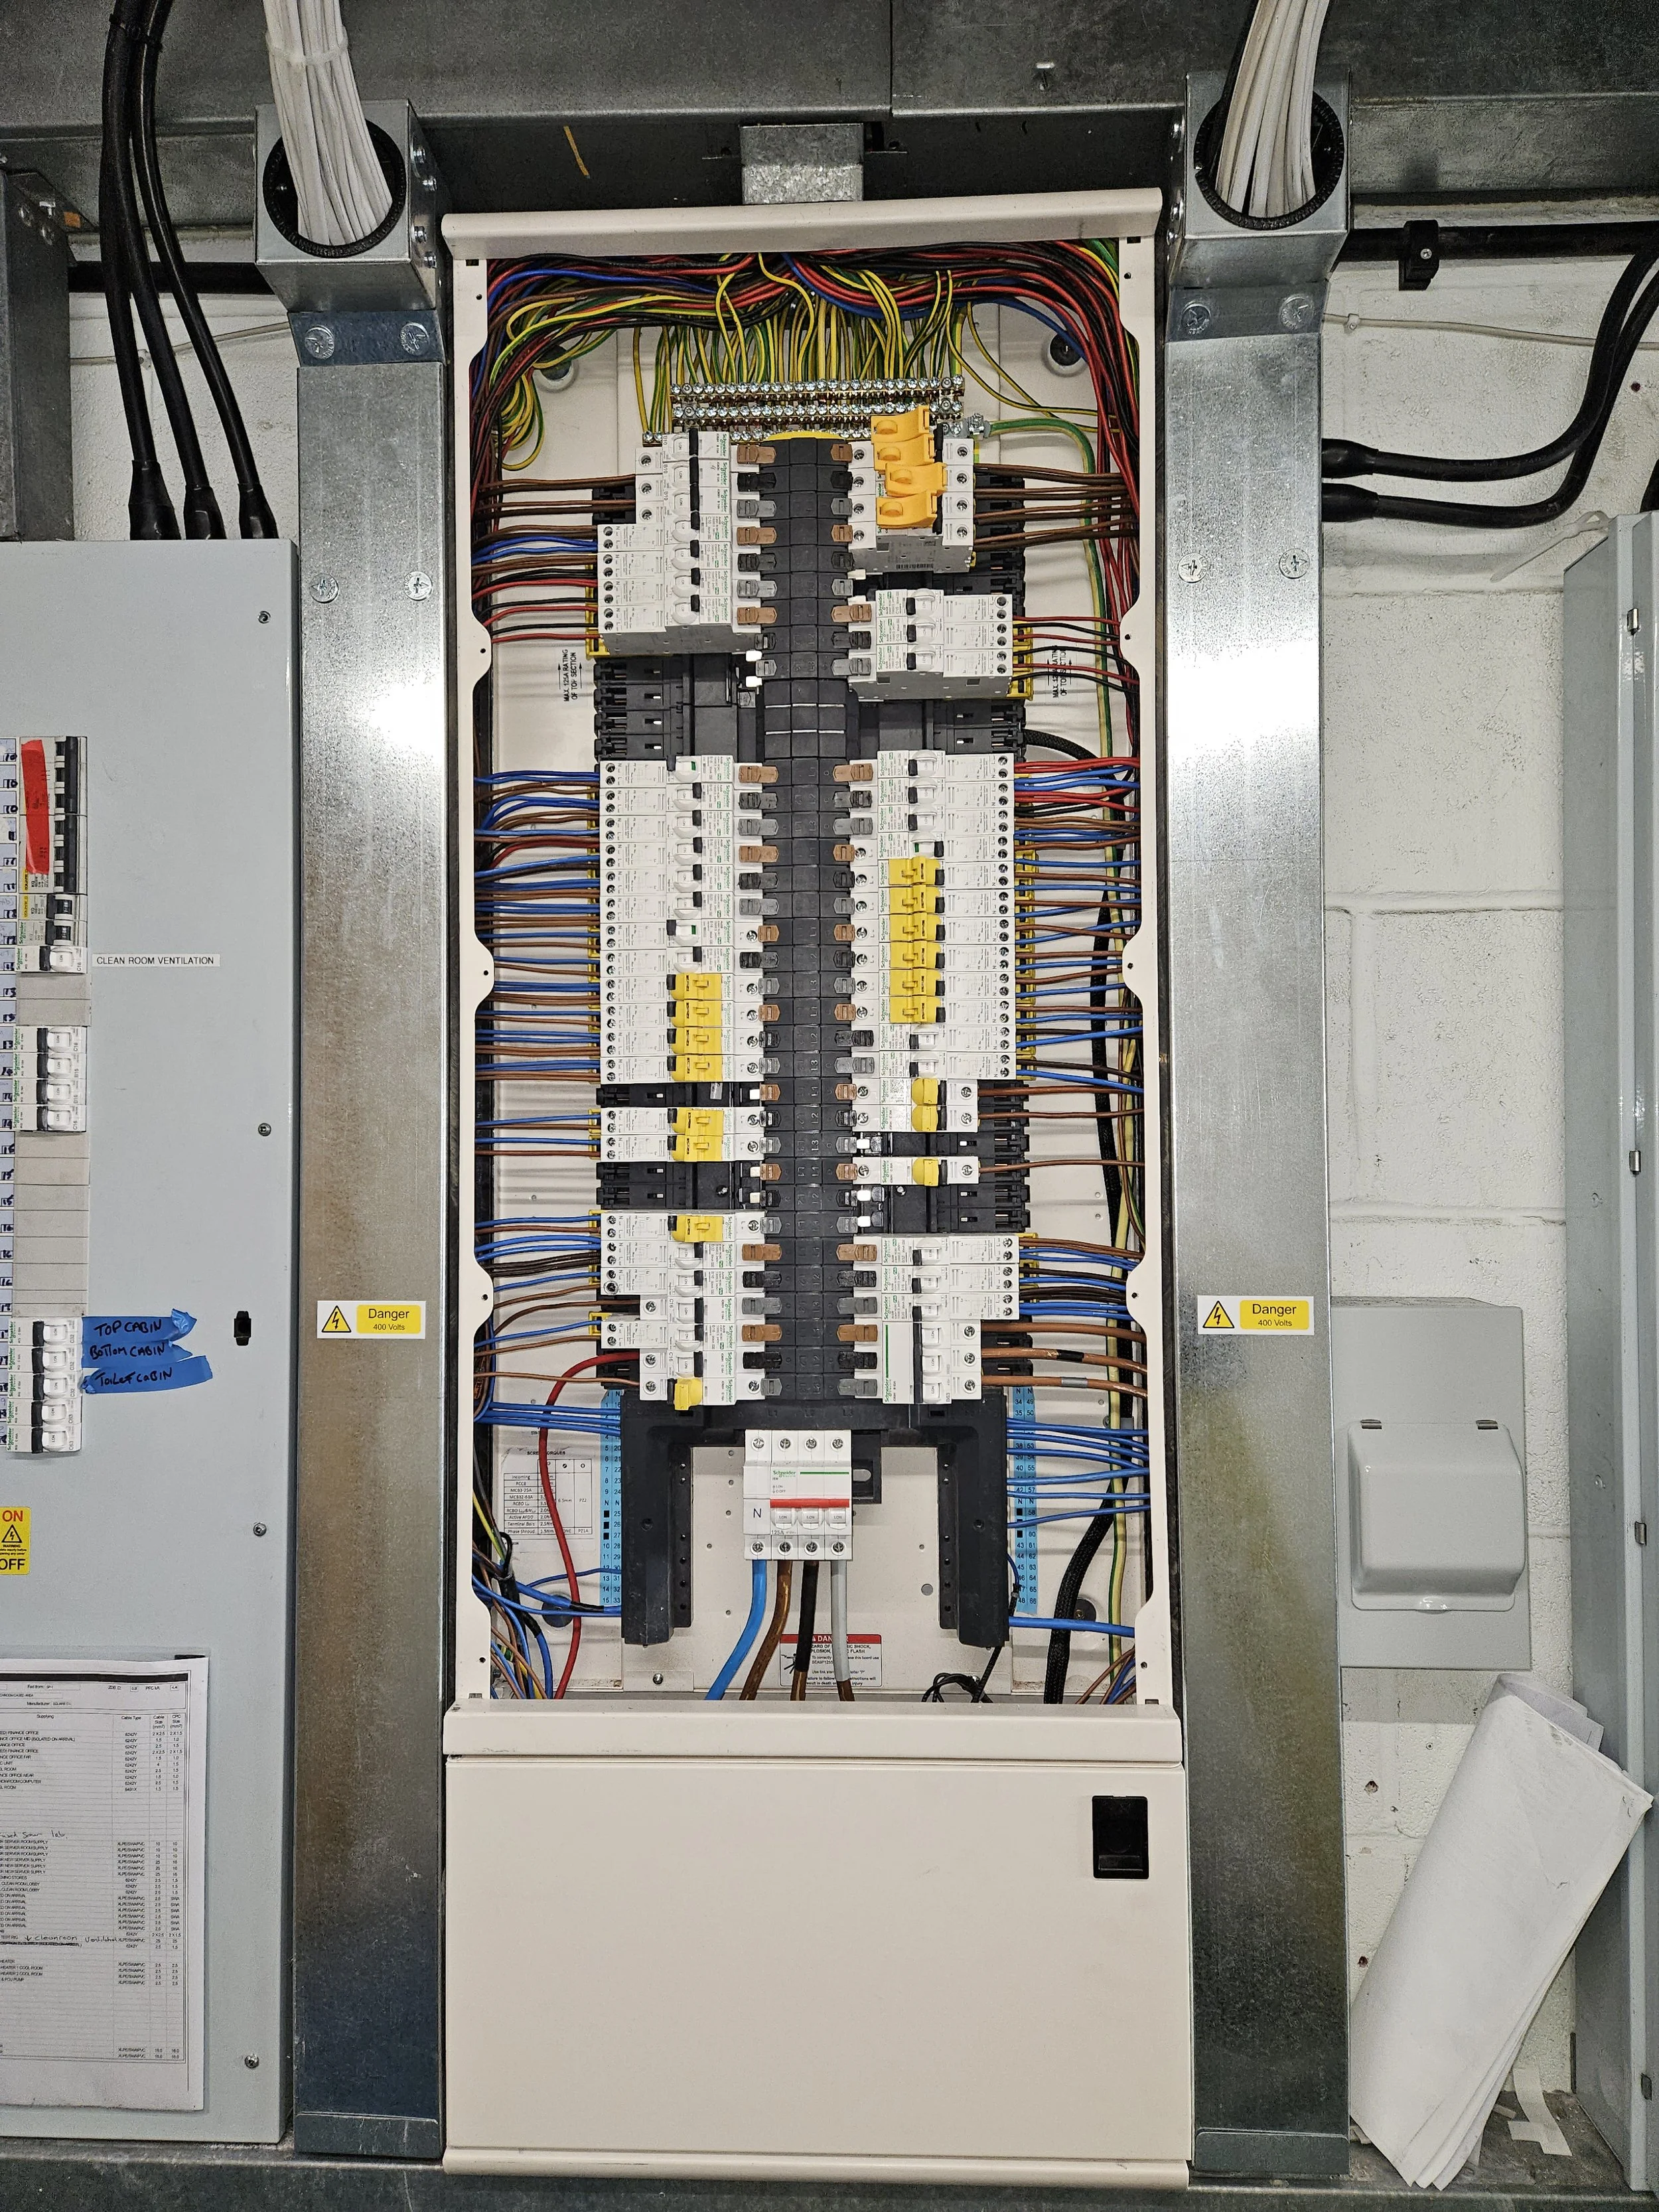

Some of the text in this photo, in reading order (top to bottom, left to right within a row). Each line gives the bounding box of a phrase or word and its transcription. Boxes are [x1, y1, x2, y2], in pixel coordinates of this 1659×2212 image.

[368, 1308, 409, 1321] Danger
[1252, 1303, 1297, 1317] Danger
[94, 1319, 162, 1337] TOP CABIN
[129, 1342, 165, 1357] CABIN
[2, 1510, 23, 1522] ON
[753, 1508, 762, 1518] N
[0, 1558, 26, 1570] OFF
